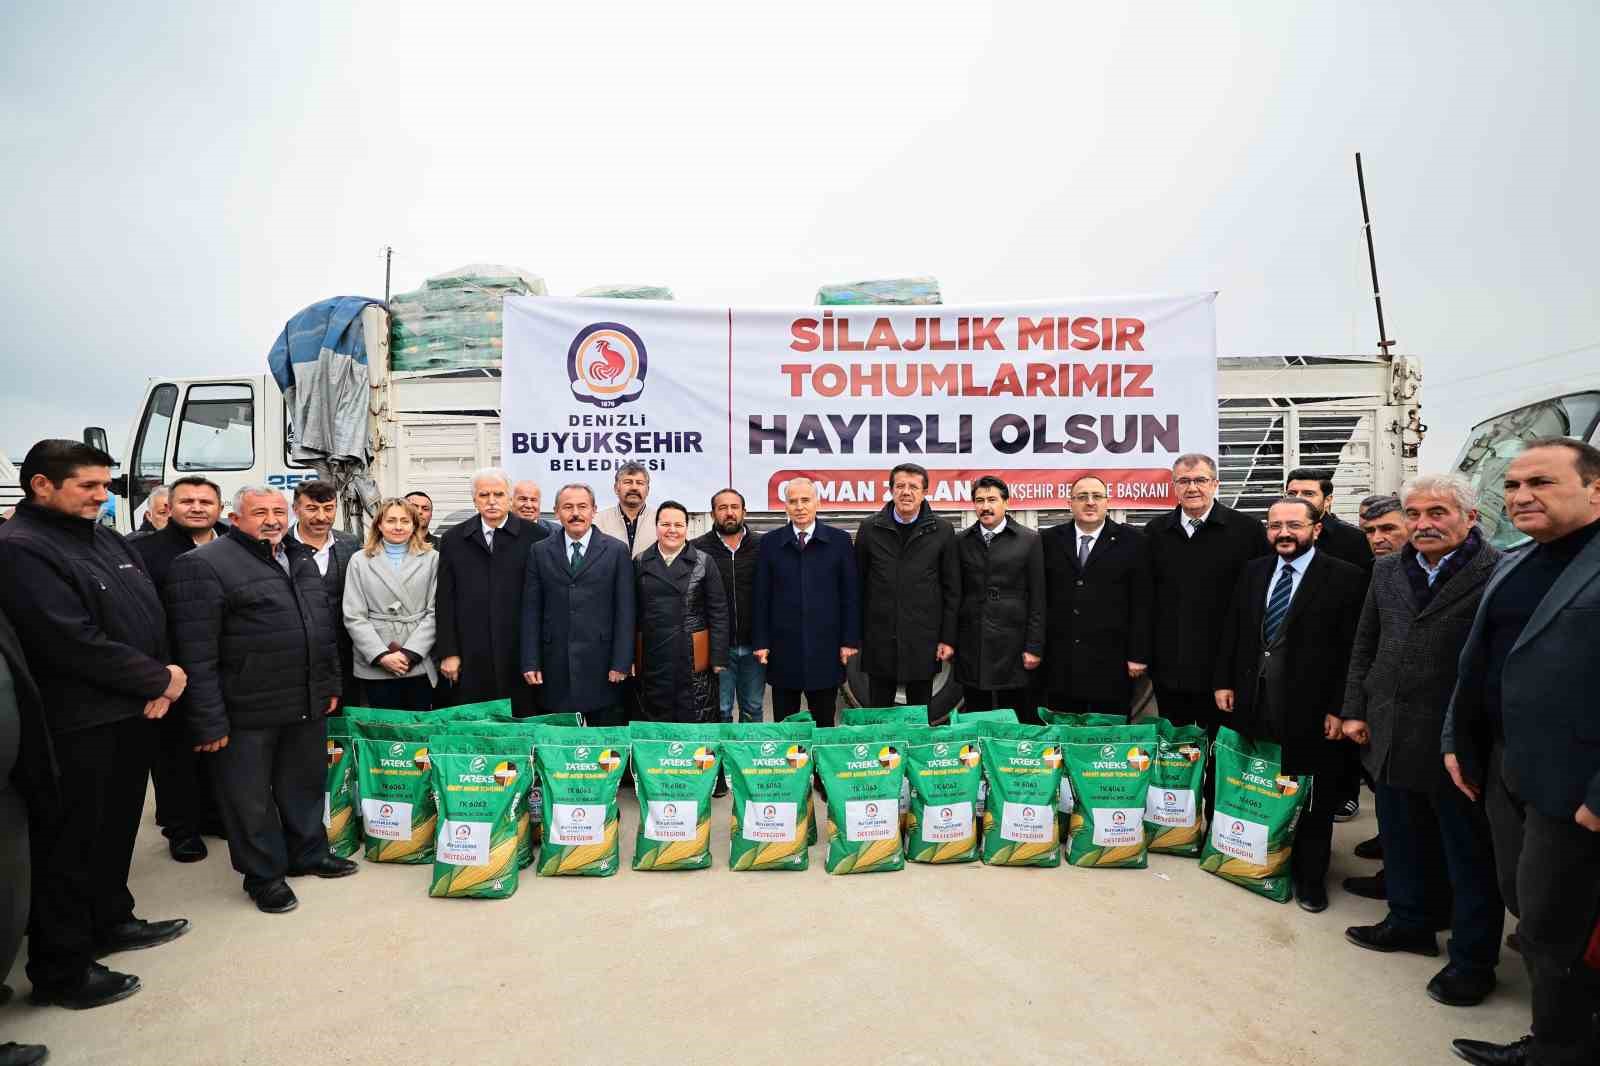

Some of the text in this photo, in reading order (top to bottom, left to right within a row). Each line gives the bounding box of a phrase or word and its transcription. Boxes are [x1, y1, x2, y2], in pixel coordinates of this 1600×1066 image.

[790, 310, 1145, 352] SİLAJLIK MISIR
[781, 363, 1154, 398] TOHUMLARIMIZ
[569, 414, 646, 427] DENİZLİ
[748, 413, 1180, 455] HAYIRLI OLSUN
[511, 431, 704, 455] BÜYÜKŞEHİR
[550, 459, 665, 472] BELEDİSİ
[777, 480, 874, 502] MAN
[1117, 483, 1169, 500] BAŞKANI
[380, 759, 413, 768] TAREKS
[660, 758, 692, 767] TAREKS
[752, 758, 785, 766] TAREKS
[848, 760, 879, 769] TAREKS
[928, 759, 958, 767] TAREKS
[1009, 757, 1041, 765] TAREKS
[458, 774, 495, 783] TAREKS
[1241, 771, 1273, 788] TAREKS
